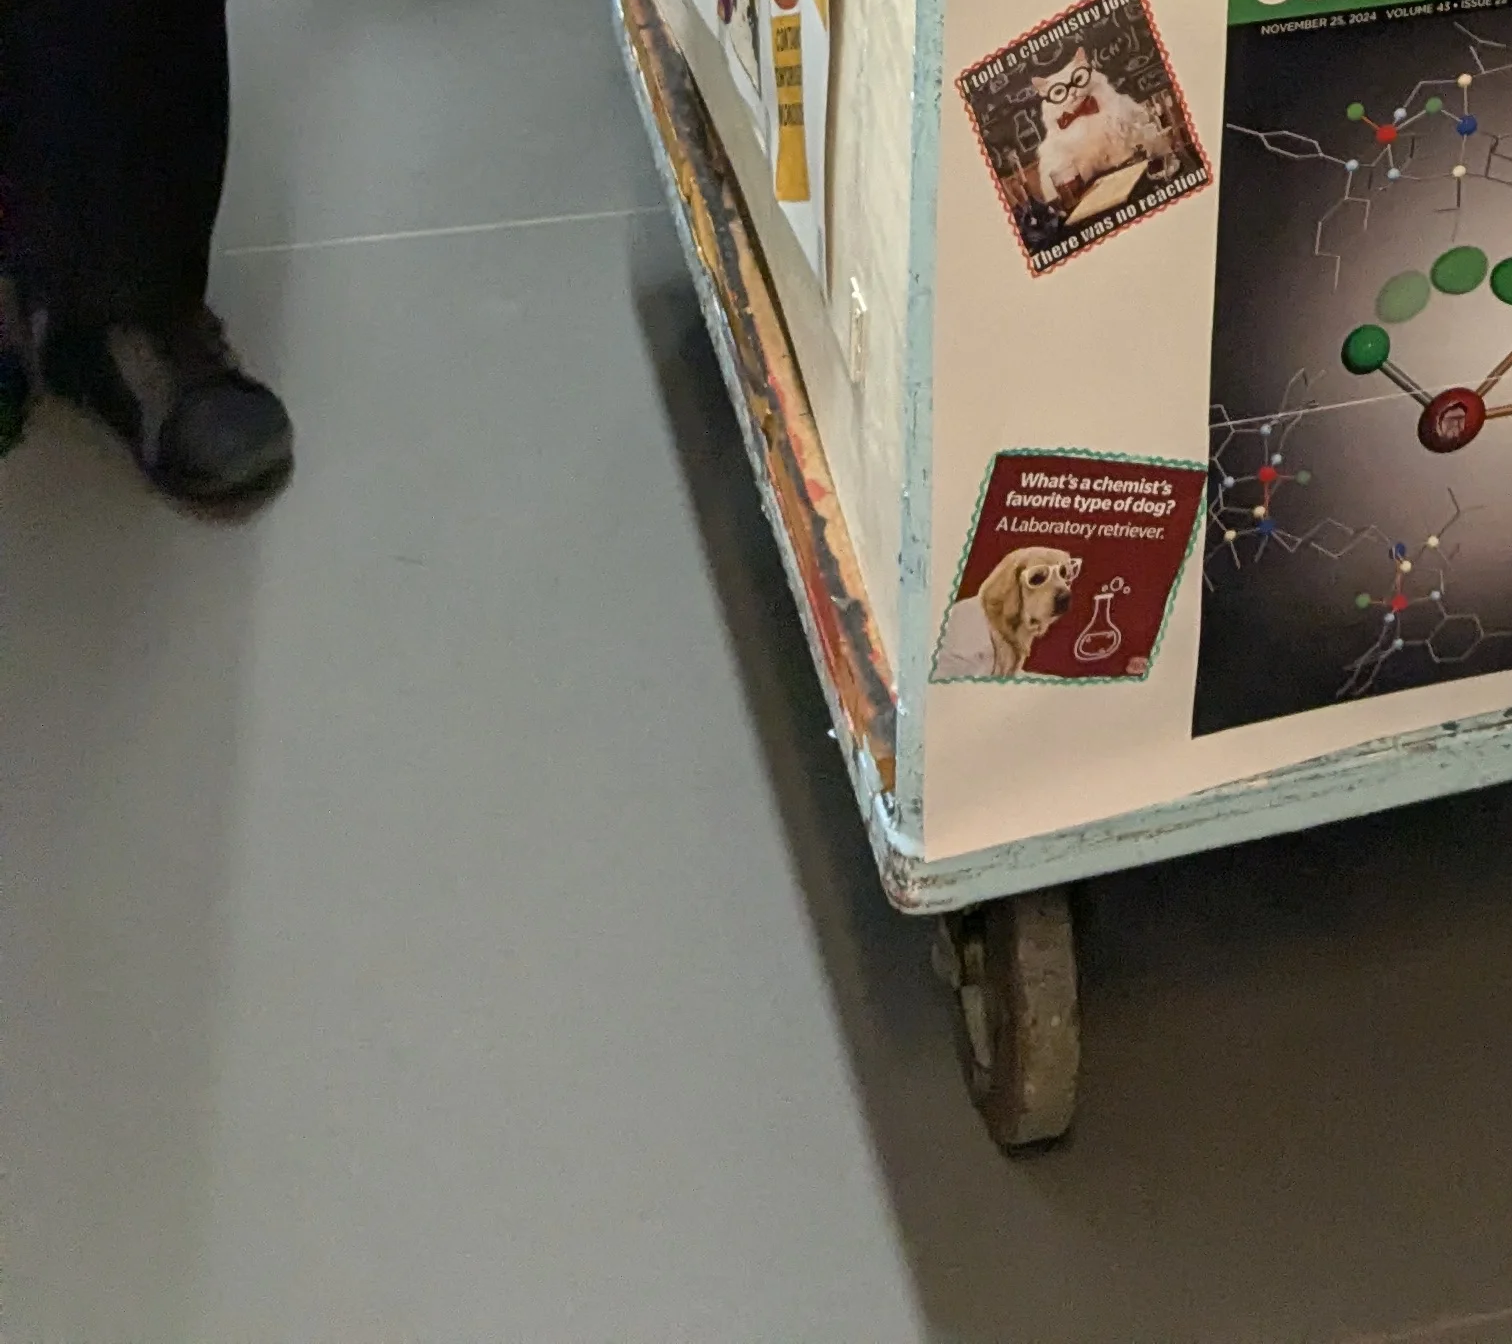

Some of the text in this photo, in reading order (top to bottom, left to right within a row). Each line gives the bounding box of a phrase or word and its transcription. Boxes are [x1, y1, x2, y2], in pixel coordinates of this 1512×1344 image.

[1260, 17, 1327, 36] NOVEMBER
[1349, 11, 1378, 25] 2024
[1385, 3, 1434, 20] VOLUME
[1436, 1, 1451, 13] 43
[971, 58, 1006, 88] told
[1006, 51, 1018, 68] a
[1019, 4, 1102, 62] chemistry
[1031, 166, 1208, 271] There was no reaction
[1020, 472, 1173, 497] What's a chemist's
[1005, 490, 1177, 518] favorite type of dog?
[995, 515, 1165, 540] A Laboratory retriever.
